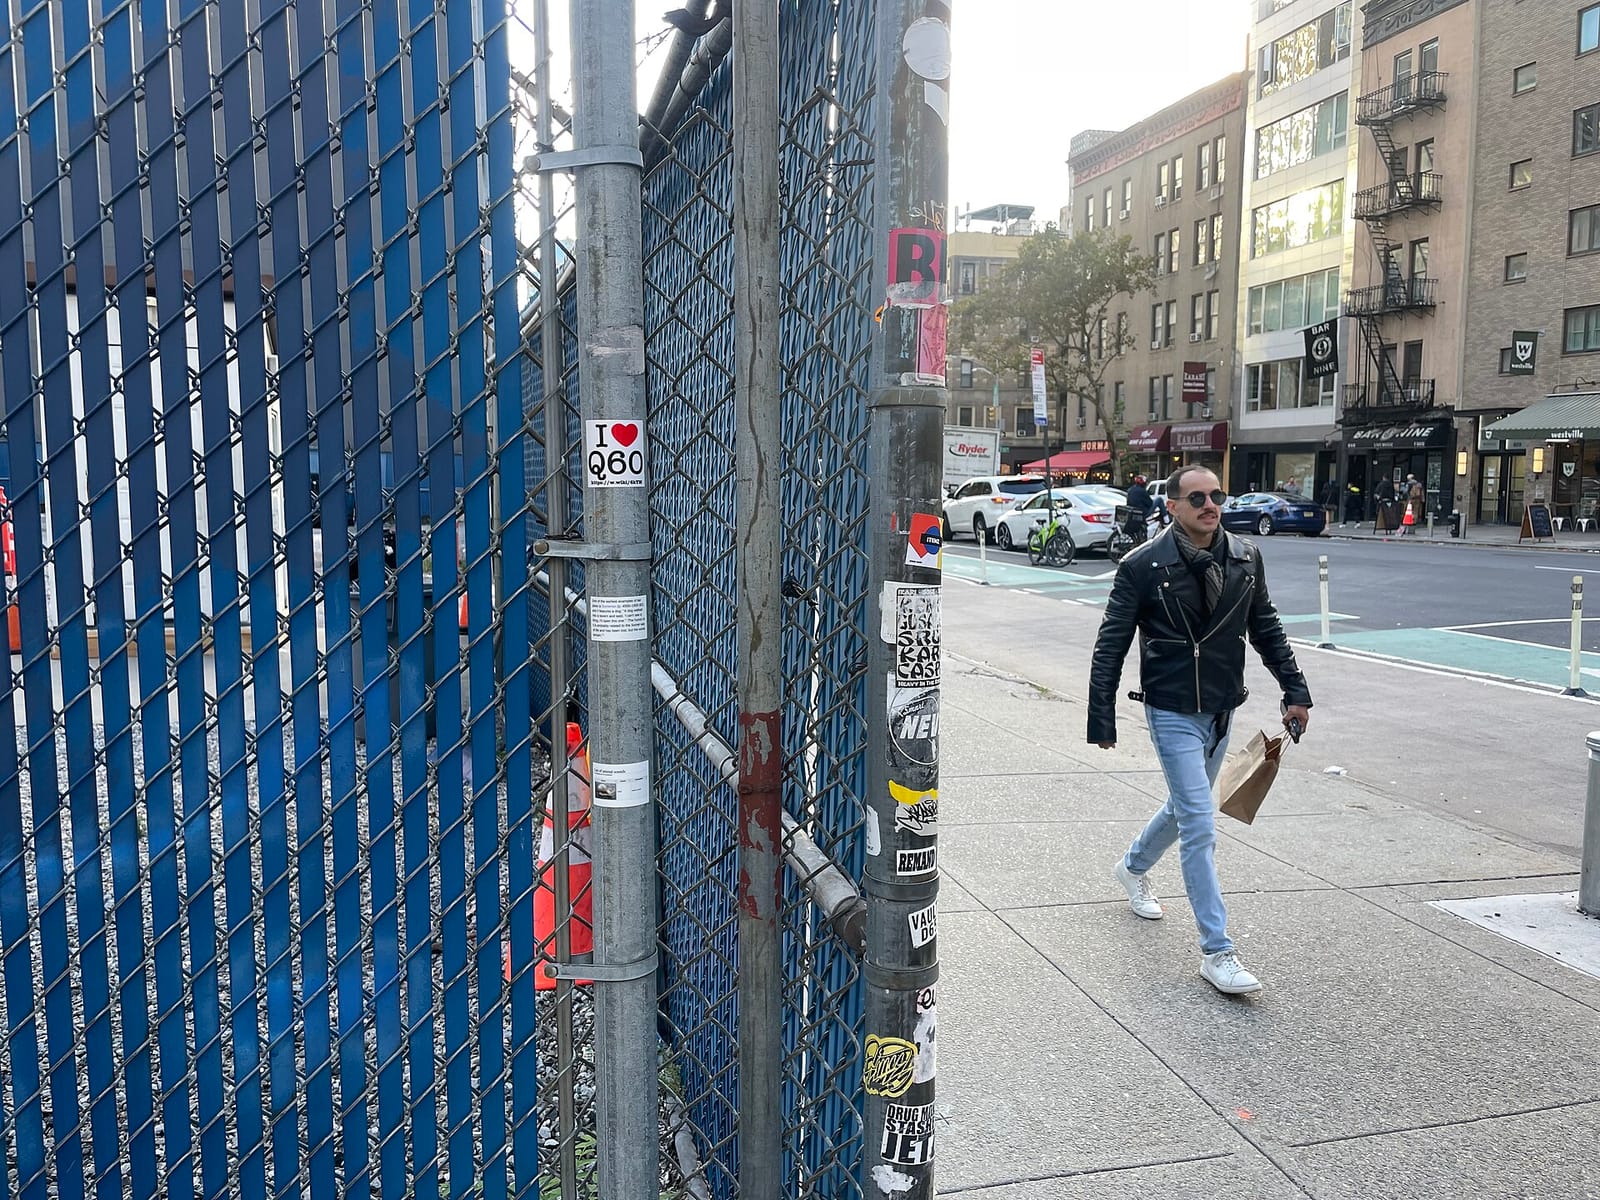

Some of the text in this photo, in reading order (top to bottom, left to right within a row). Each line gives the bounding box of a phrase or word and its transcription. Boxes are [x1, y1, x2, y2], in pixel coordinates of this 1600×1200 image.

[1311, 322, 1330, 335] BAR
[1518, 344, 1530, 354] W
[1313, 361, 1335, 375] NINE
[595, 424, 608, 447] I
[1550, 429, 1584, 438] westville
[958, 443, 988, 454] Ryder
[588, 450, 643, 480] Q60
[1564, 464, 1574, 472] W
[912, 901, 937, 930] VAUL
[887, 1105, 919, 1121] DRUG
[886, 1118, 934, 1134] STASH
[881, 1132, 935, 1164] JET
